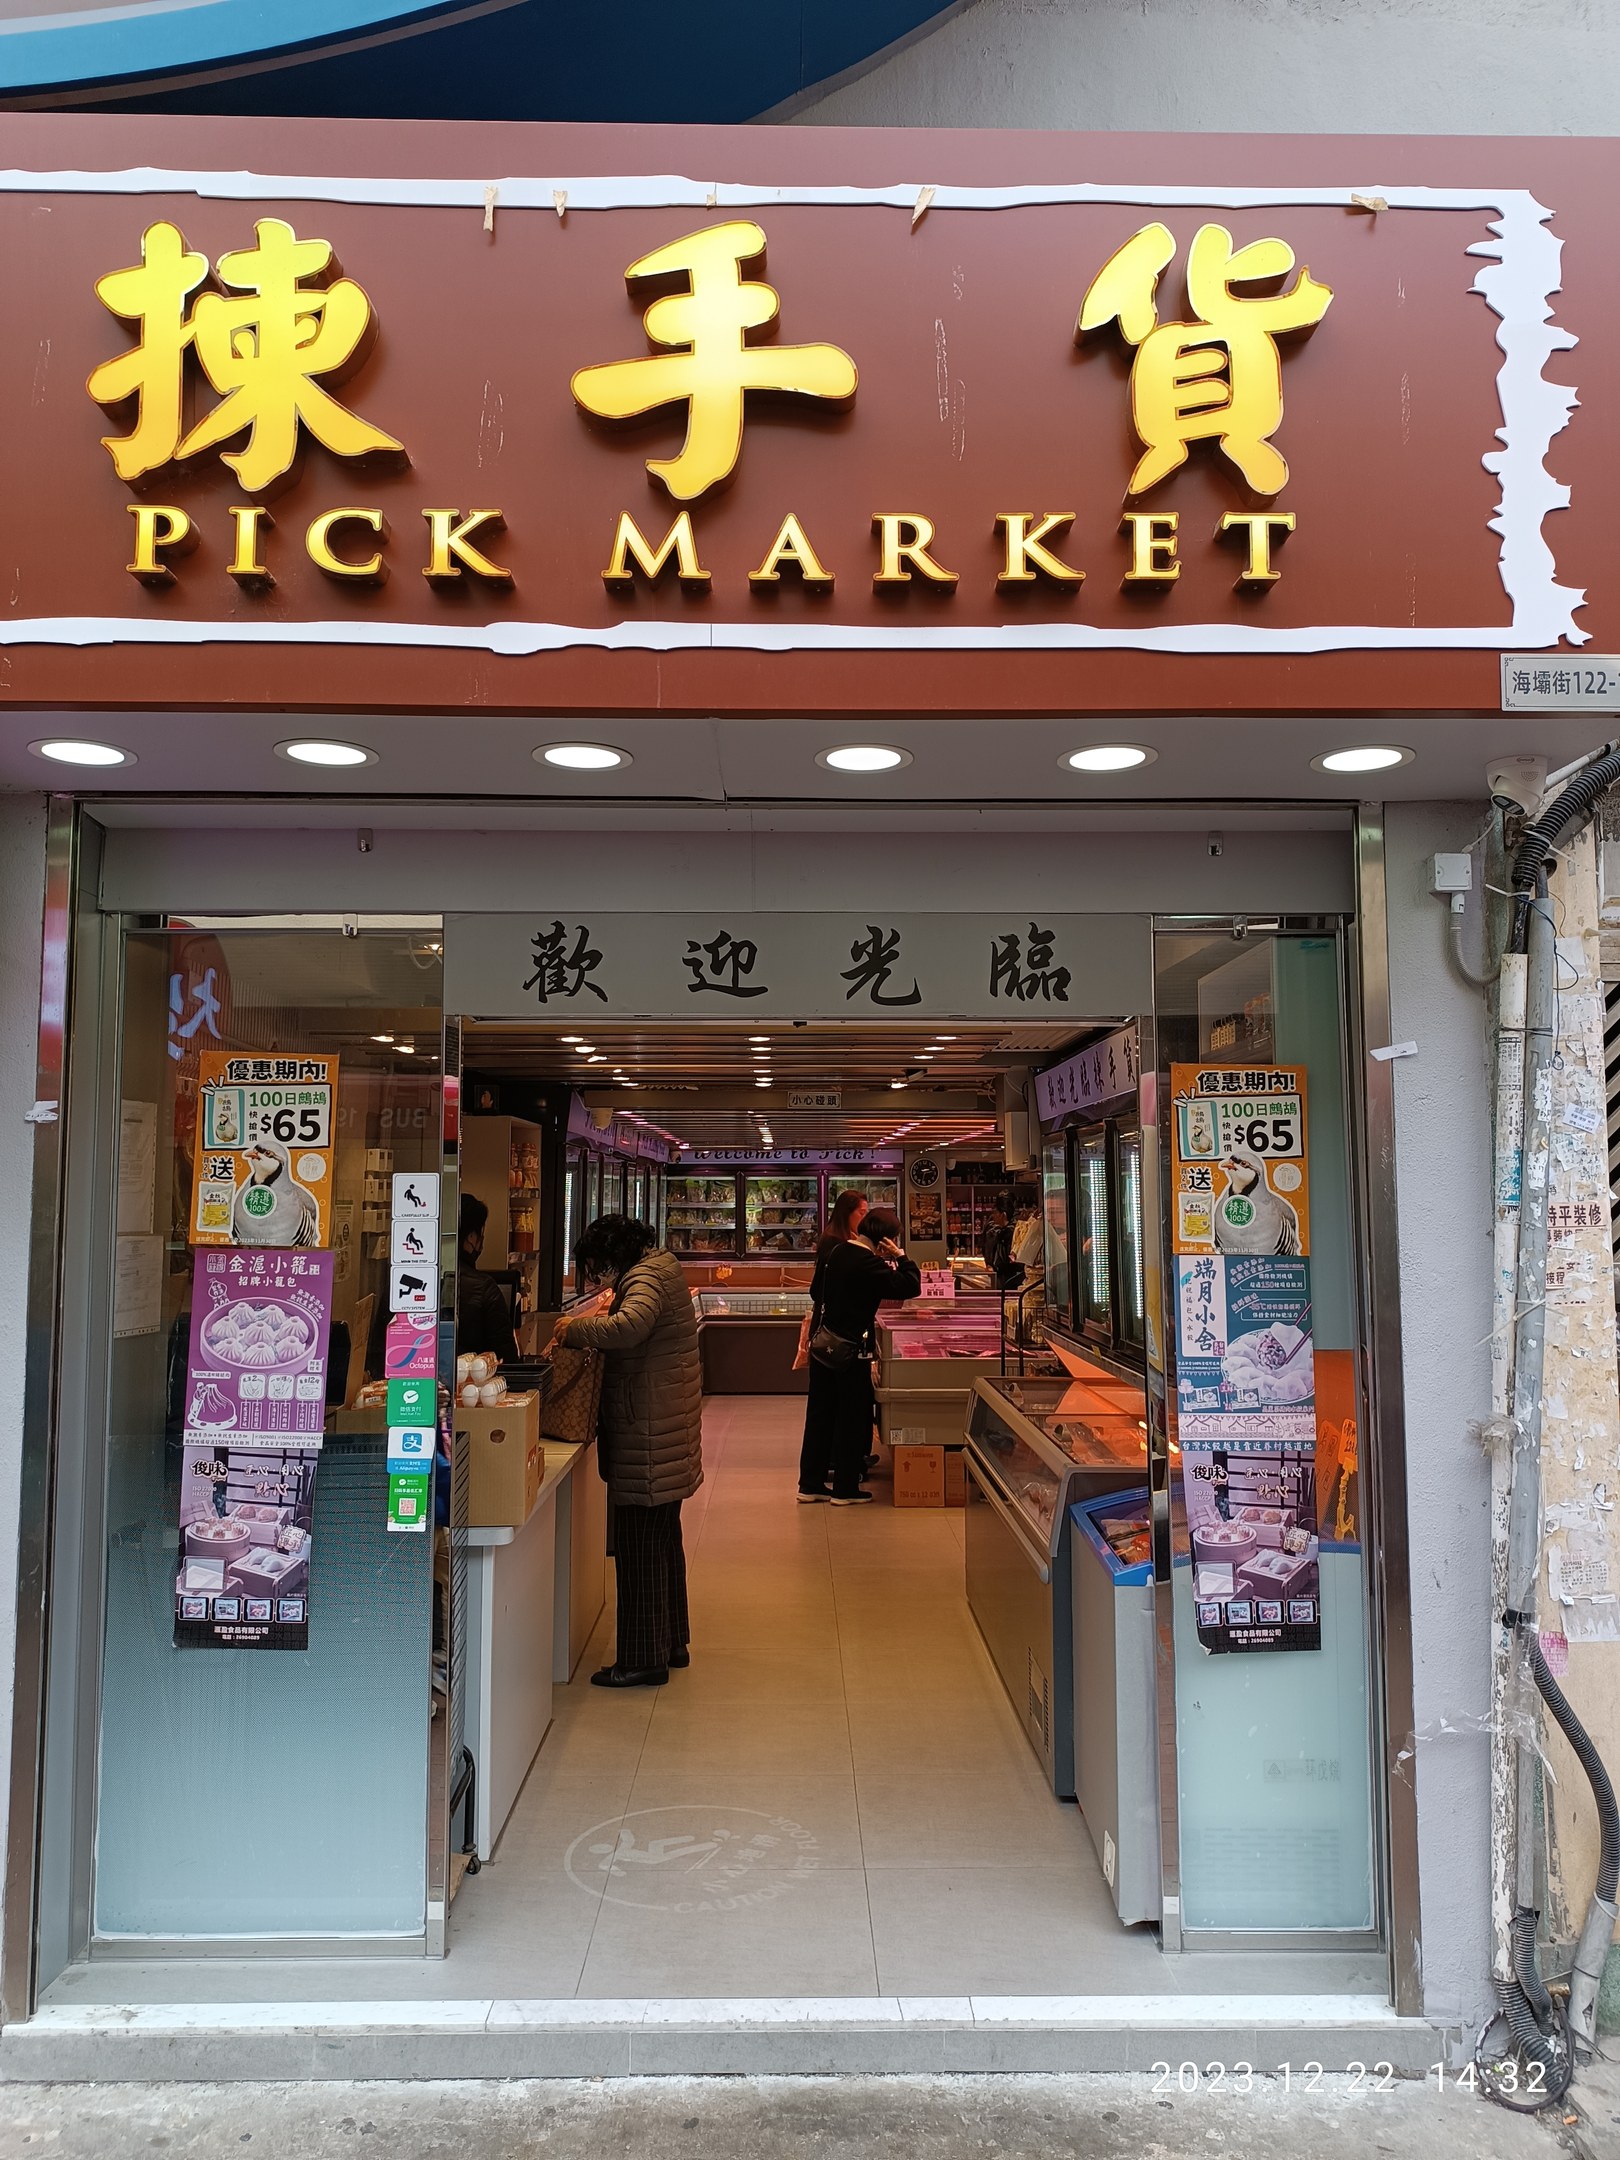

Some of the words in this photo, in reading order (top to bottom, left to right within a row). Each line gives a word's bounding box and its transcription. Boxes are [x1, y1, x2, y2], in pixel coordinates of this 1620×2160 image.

[126, 504, 513, 578] PICK
[601, 509, 1297, 585] MARKET
[1512, 670, 1620, 695] 海壩街122-
[522, 920, 1072, 1005] 歡迎光臨
[227, 1060, 326, 1081] 優惠期內!
[1198, 1071, 1295, 1092] 優惠期內!
[791, 1095, 837, 1106] 小心碰頭
[260, 1108, 321, 1142] $65
[1235, 1119, 1294, 1152] $65
[210, 1157, 233, 1180] 送
[1189, 1168, 1212, 1191] 送
[229, 1255, 308, 1275] 金滬小籠
[1193, 1257, 1217, 1352] 端月小舍
[409, 1362, 435, 1370] Octopus
[673, 1880, 795, 1914] CAUTION
